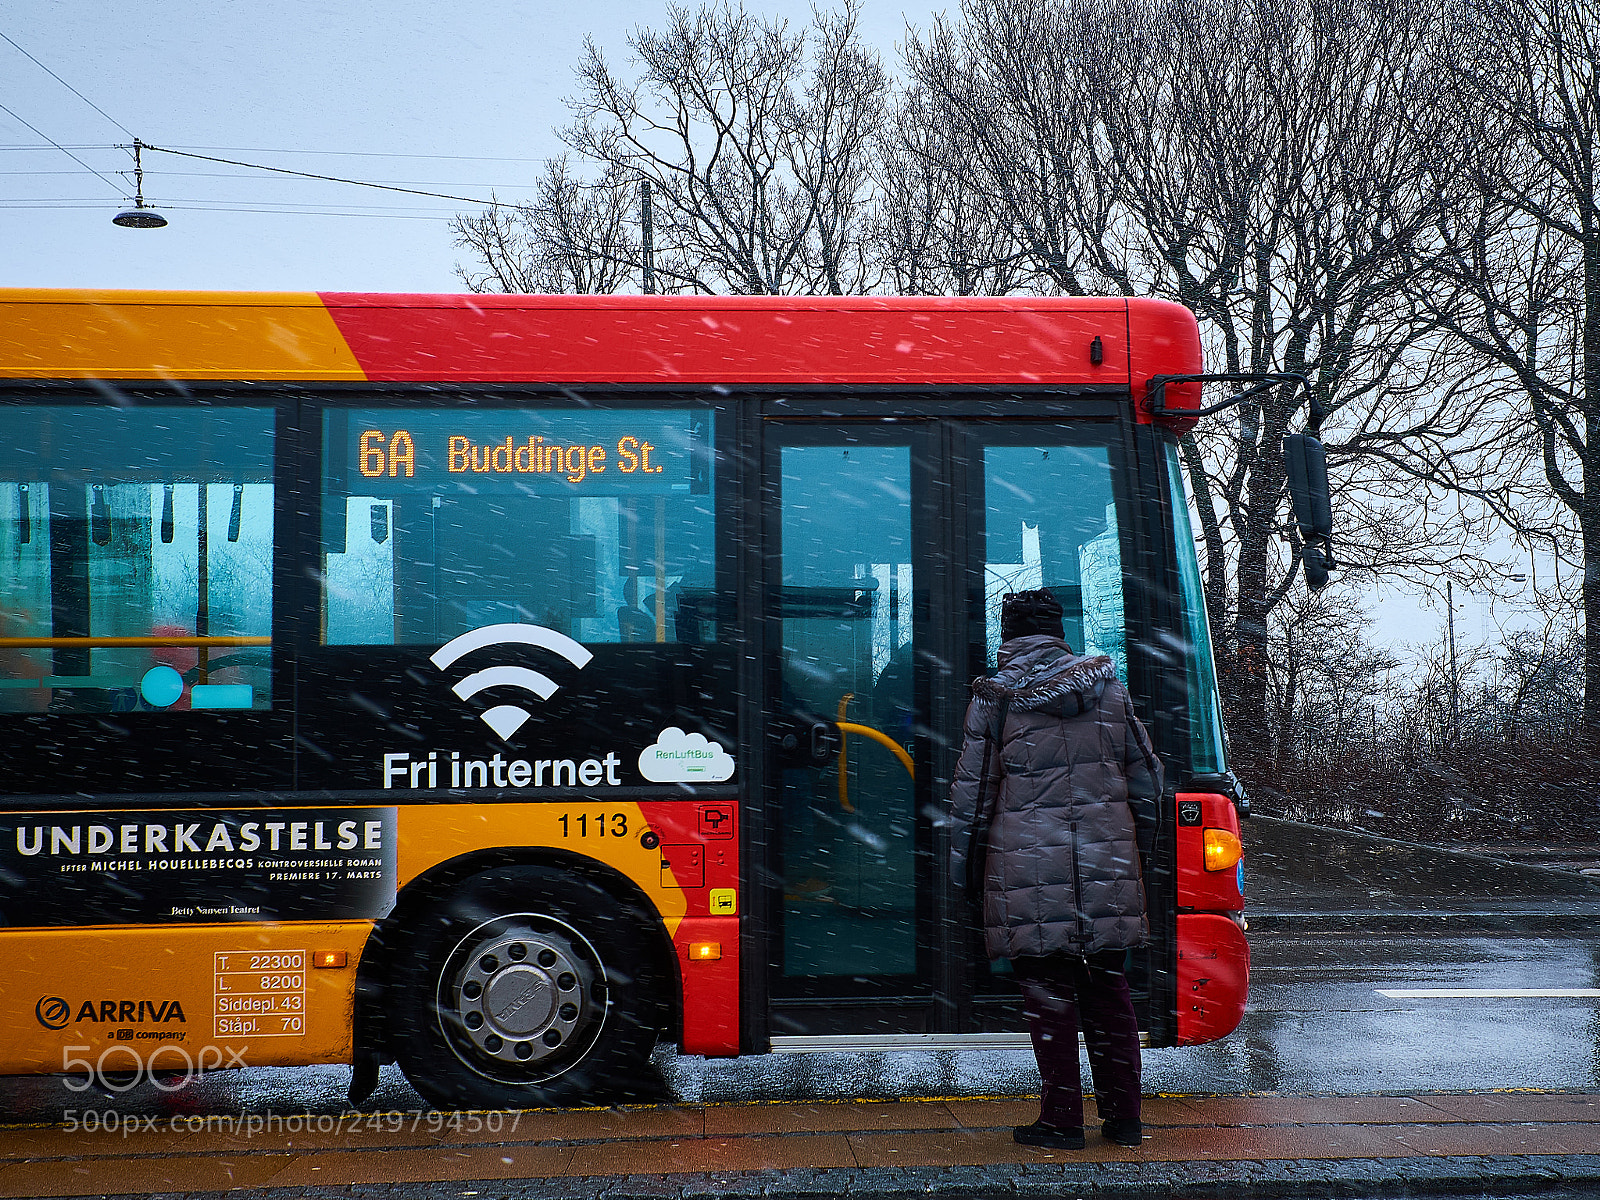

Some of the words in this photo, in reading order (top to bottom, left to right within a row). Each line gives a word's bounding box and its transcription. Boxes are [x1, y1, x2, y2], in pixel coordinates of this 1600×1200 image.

[359, 430, 415, 477] 6A
[448, 435, 606, 483] Buddinge
[617, 435, 663, 473] St.
[655, 750, 714, 759] RenLuftBus
[383, 752, 437, 788] Fri
[451, 752, 621, 788] internet
[557, 813, 628, 838] 1113
[16, 821, 382, 856] UNDERKASTELSE
[60, 864, 87, 872] EFTER
[90, 860, 142, 872] MICHEL
[148, 858, 254, 870] HOUELLEBECQS
[257, 860, 344, 868] KONTROVERSIELLE
[346, 859, 382, 867] ROMAN
[269, 873, 320, 881] PREMIERE
[325, 872, 342, 880] 17.
[346, 871, 382, 879] MARTS
[218, 956, 230, 970] T.
[249, 955, 302, 969] 22300
[219, 977, 232, 991] L.
[260, 975, 302, 989] 8200
[75, 1000, 187, 1023] ARRIVA
[217, 997, 279, 1015] Siddepl.
[280, 996, 302, 1010] 43
[217, 1017, 261, 1035] Ståpl.
[280, 1017, 302, 1031] 70
[107, 1031, 115, 1040] a
[135, 1031, 187, 1042] company
